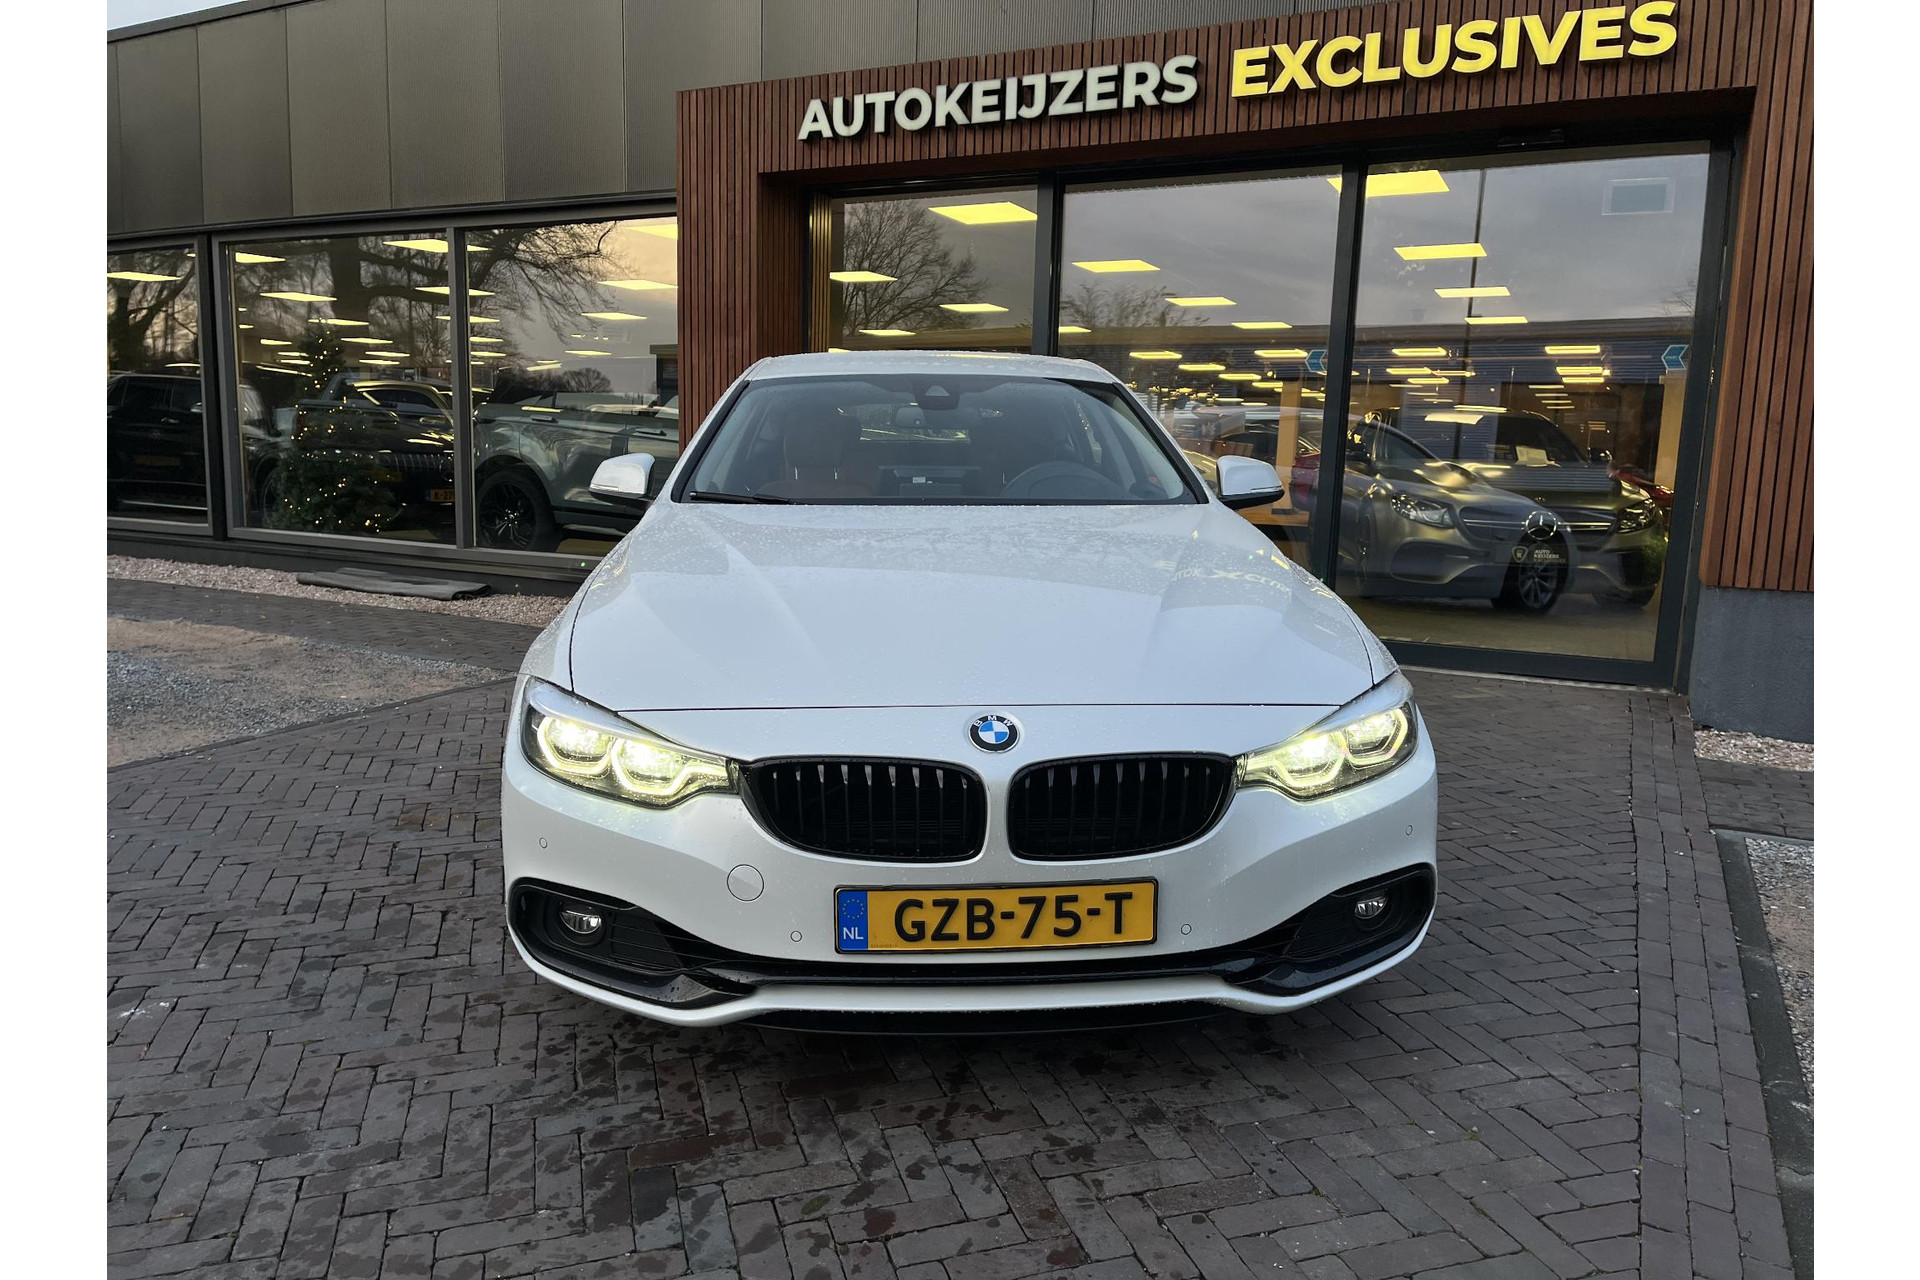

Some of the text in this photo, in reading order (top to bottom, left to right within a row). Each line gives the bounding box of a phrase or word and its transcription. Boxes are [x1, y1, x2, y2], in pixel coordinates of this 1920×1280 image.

[797, 1, 1677, 140] AUTOKEIJZERS EXCLUSIVES
[973, 715, 1013, 727] BMW
[894, 891, 1133, 942] GZB-75-T
[843, 926, 864, 940] NL
